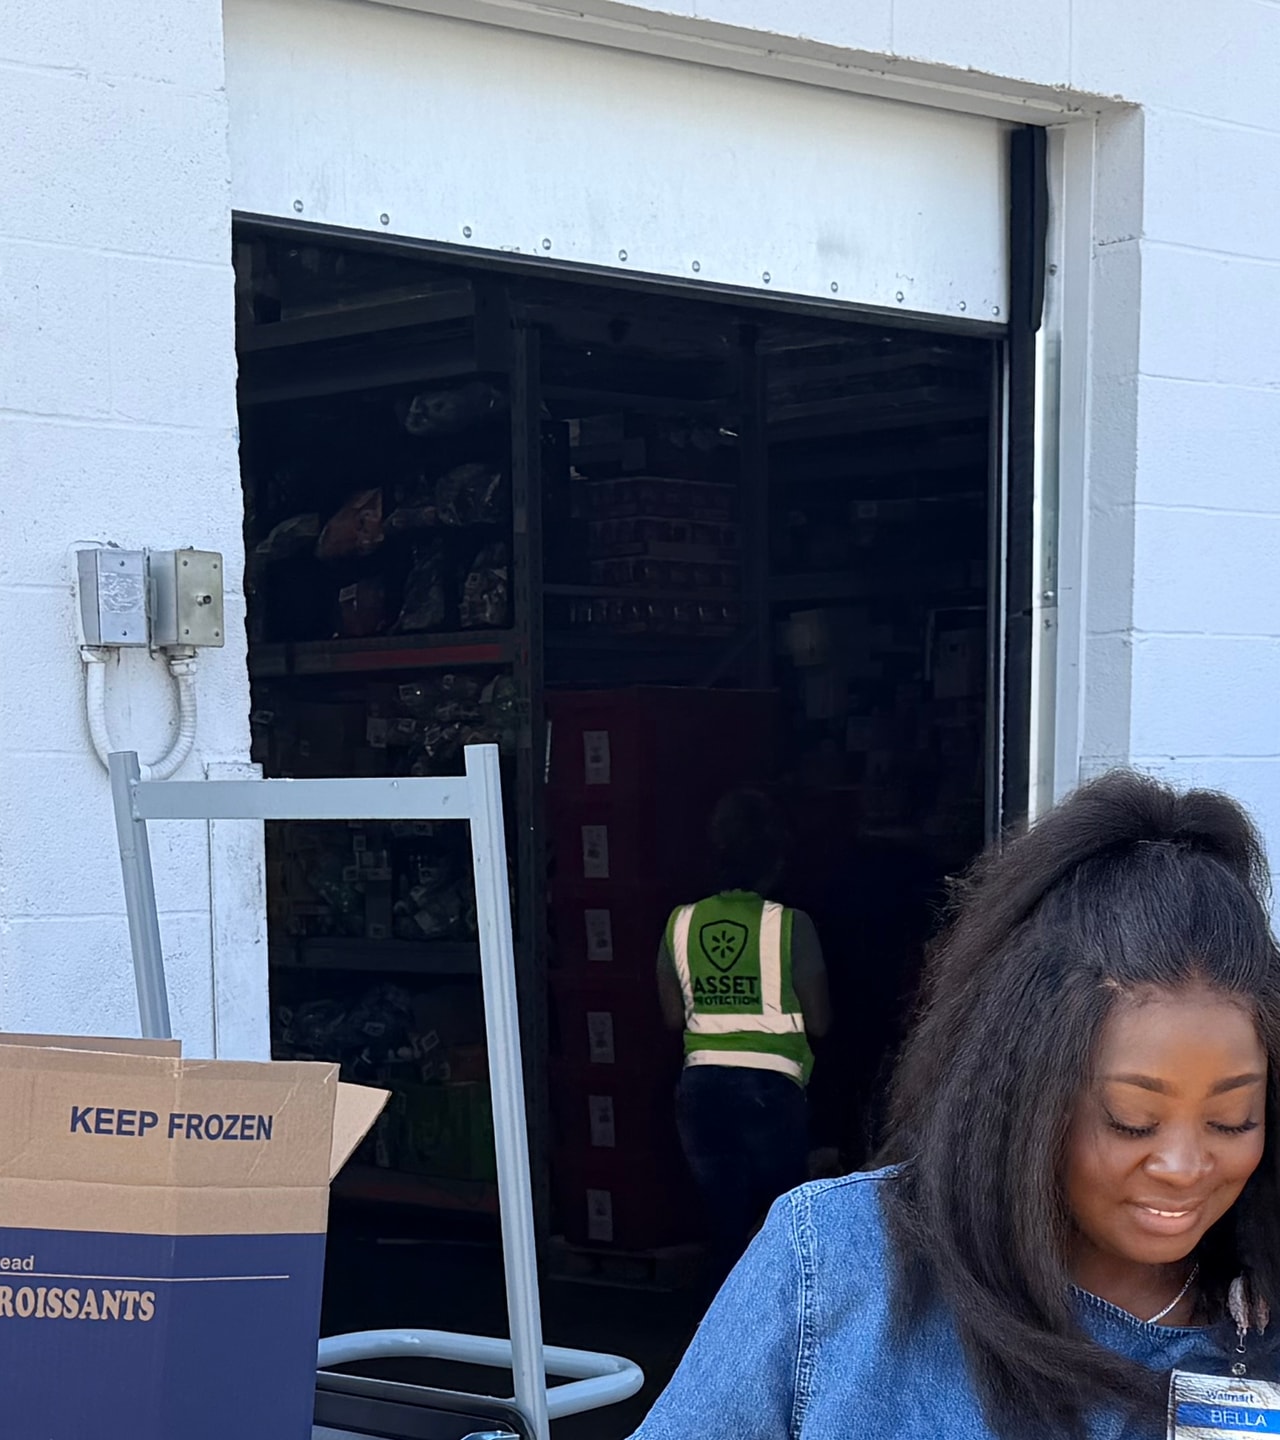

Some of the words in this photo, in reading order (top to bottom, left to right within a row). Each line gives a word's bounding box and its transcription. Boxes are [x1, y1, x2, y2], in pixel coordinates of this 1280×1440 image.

[694, 975, 758, 995] ASSET
[69, 1106, 159, 1137] KEEP
[168, 1112, 273, 1141] FROZEN
[1211, 1410, 1267, 1428] BELLA
